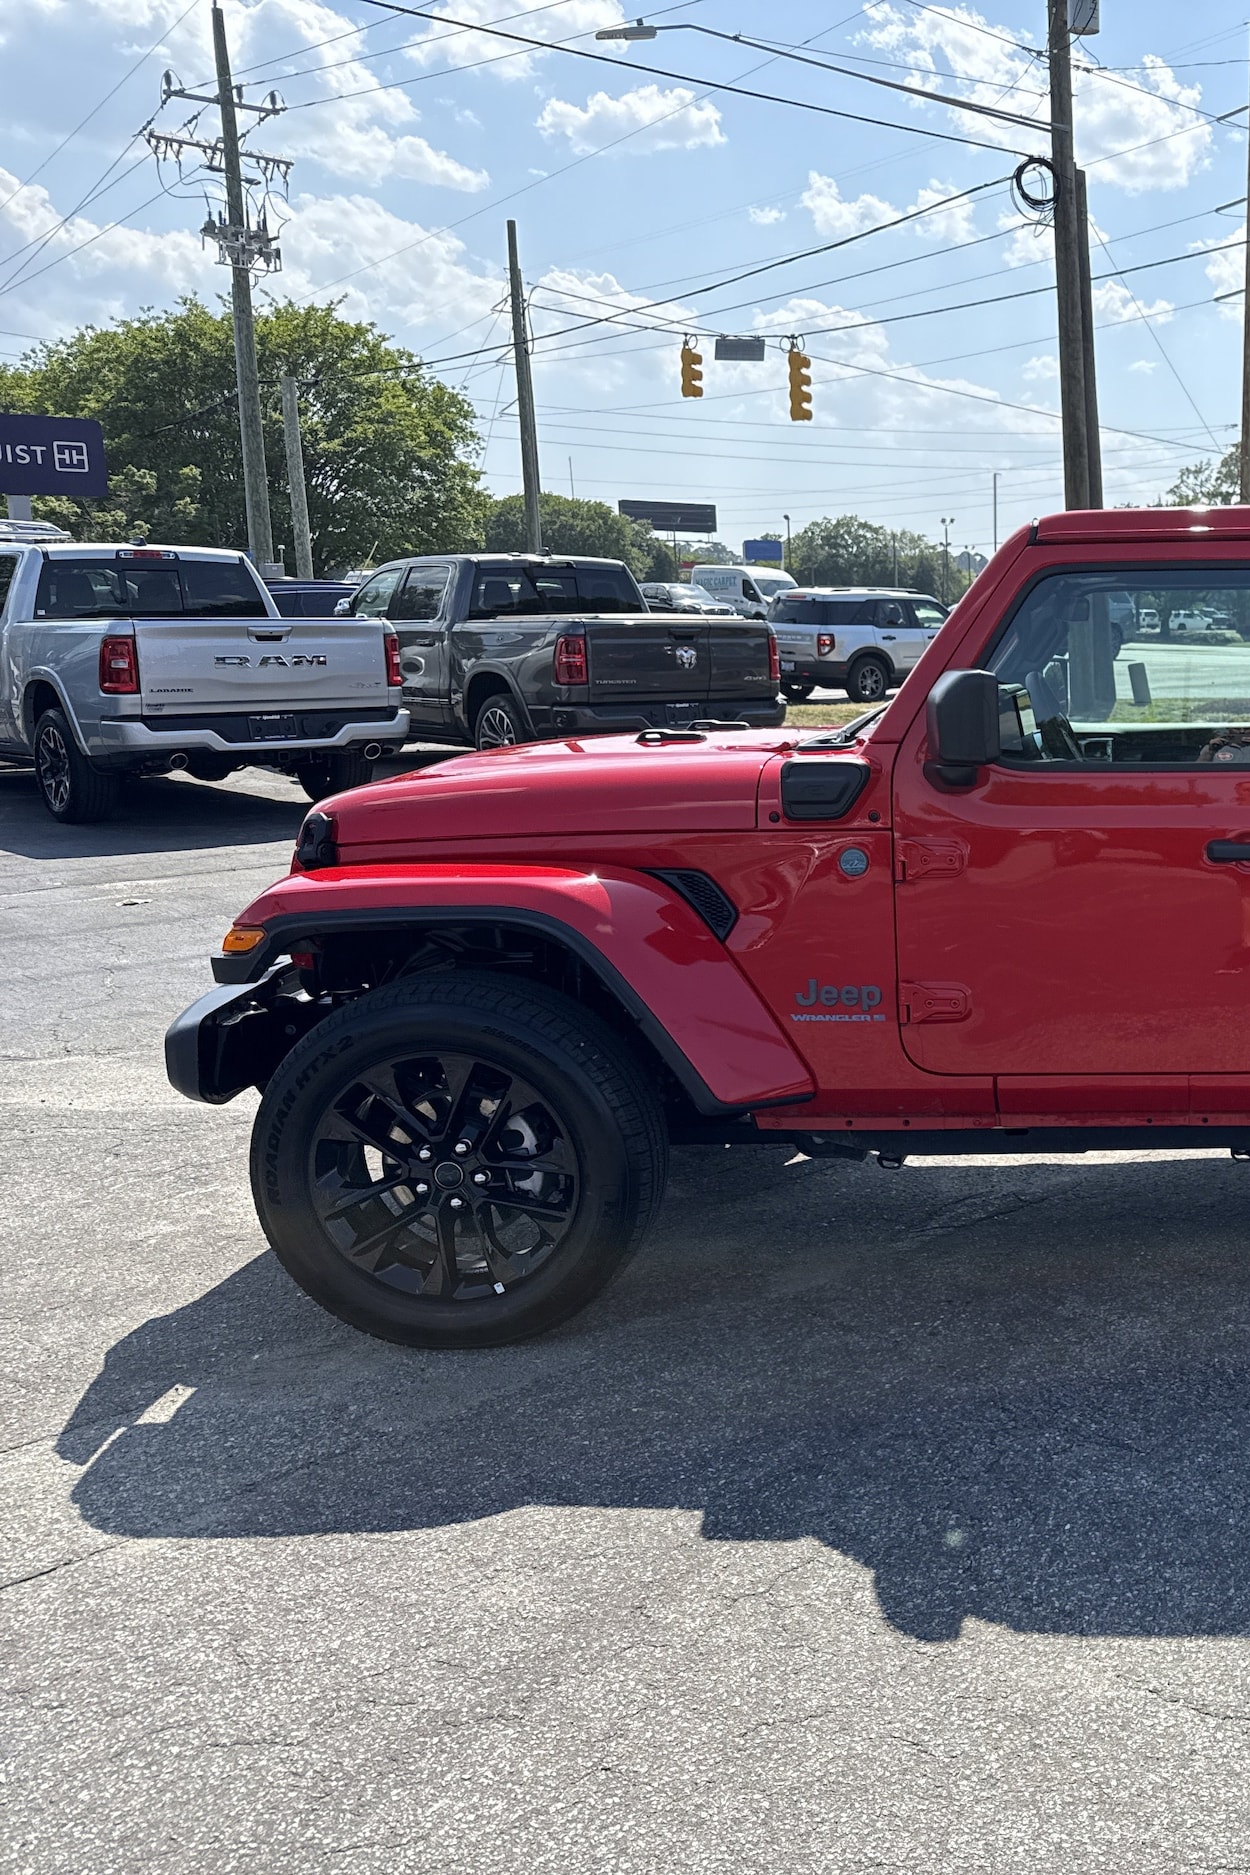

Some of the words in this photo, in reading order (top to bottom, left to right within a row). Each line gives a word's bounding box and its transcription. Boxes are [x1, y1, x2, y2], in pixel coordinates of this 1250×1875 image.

[0, 444, 46, 465] IST
[714, 576, 737, 586] CARPET
[213, 654, 327, 670] RAM
[795, 979, 882, 1011] Jeep
[790, 1014, 871, 1022] WRANGLER
[265, 1088, 297, 1206] ROADIAN
